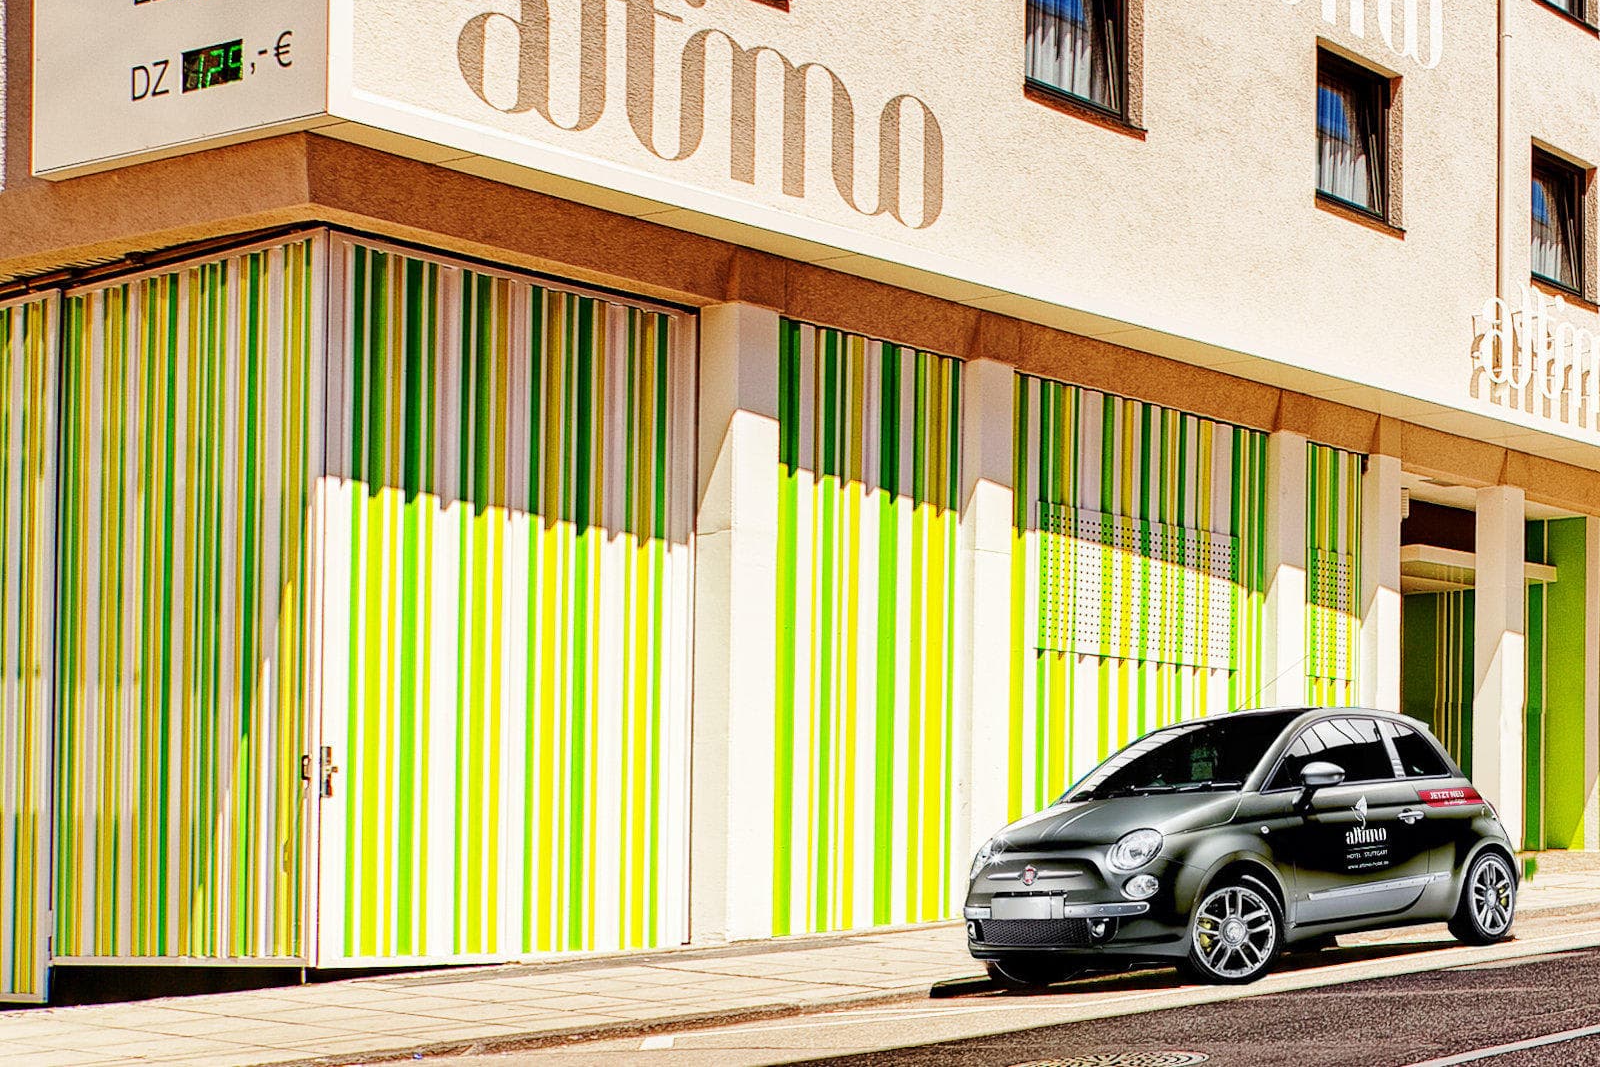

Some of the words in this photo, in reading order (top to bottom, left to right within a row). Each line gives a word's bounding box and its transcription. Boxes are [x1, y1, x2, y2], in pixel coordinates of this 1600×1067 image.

[131, 59, 170, 102] DZ
[1430, 791, 1450, 800] JETZT
[1450, 790, 1465, 798] NEU
[1345, 826, 1387, 844] attimo
